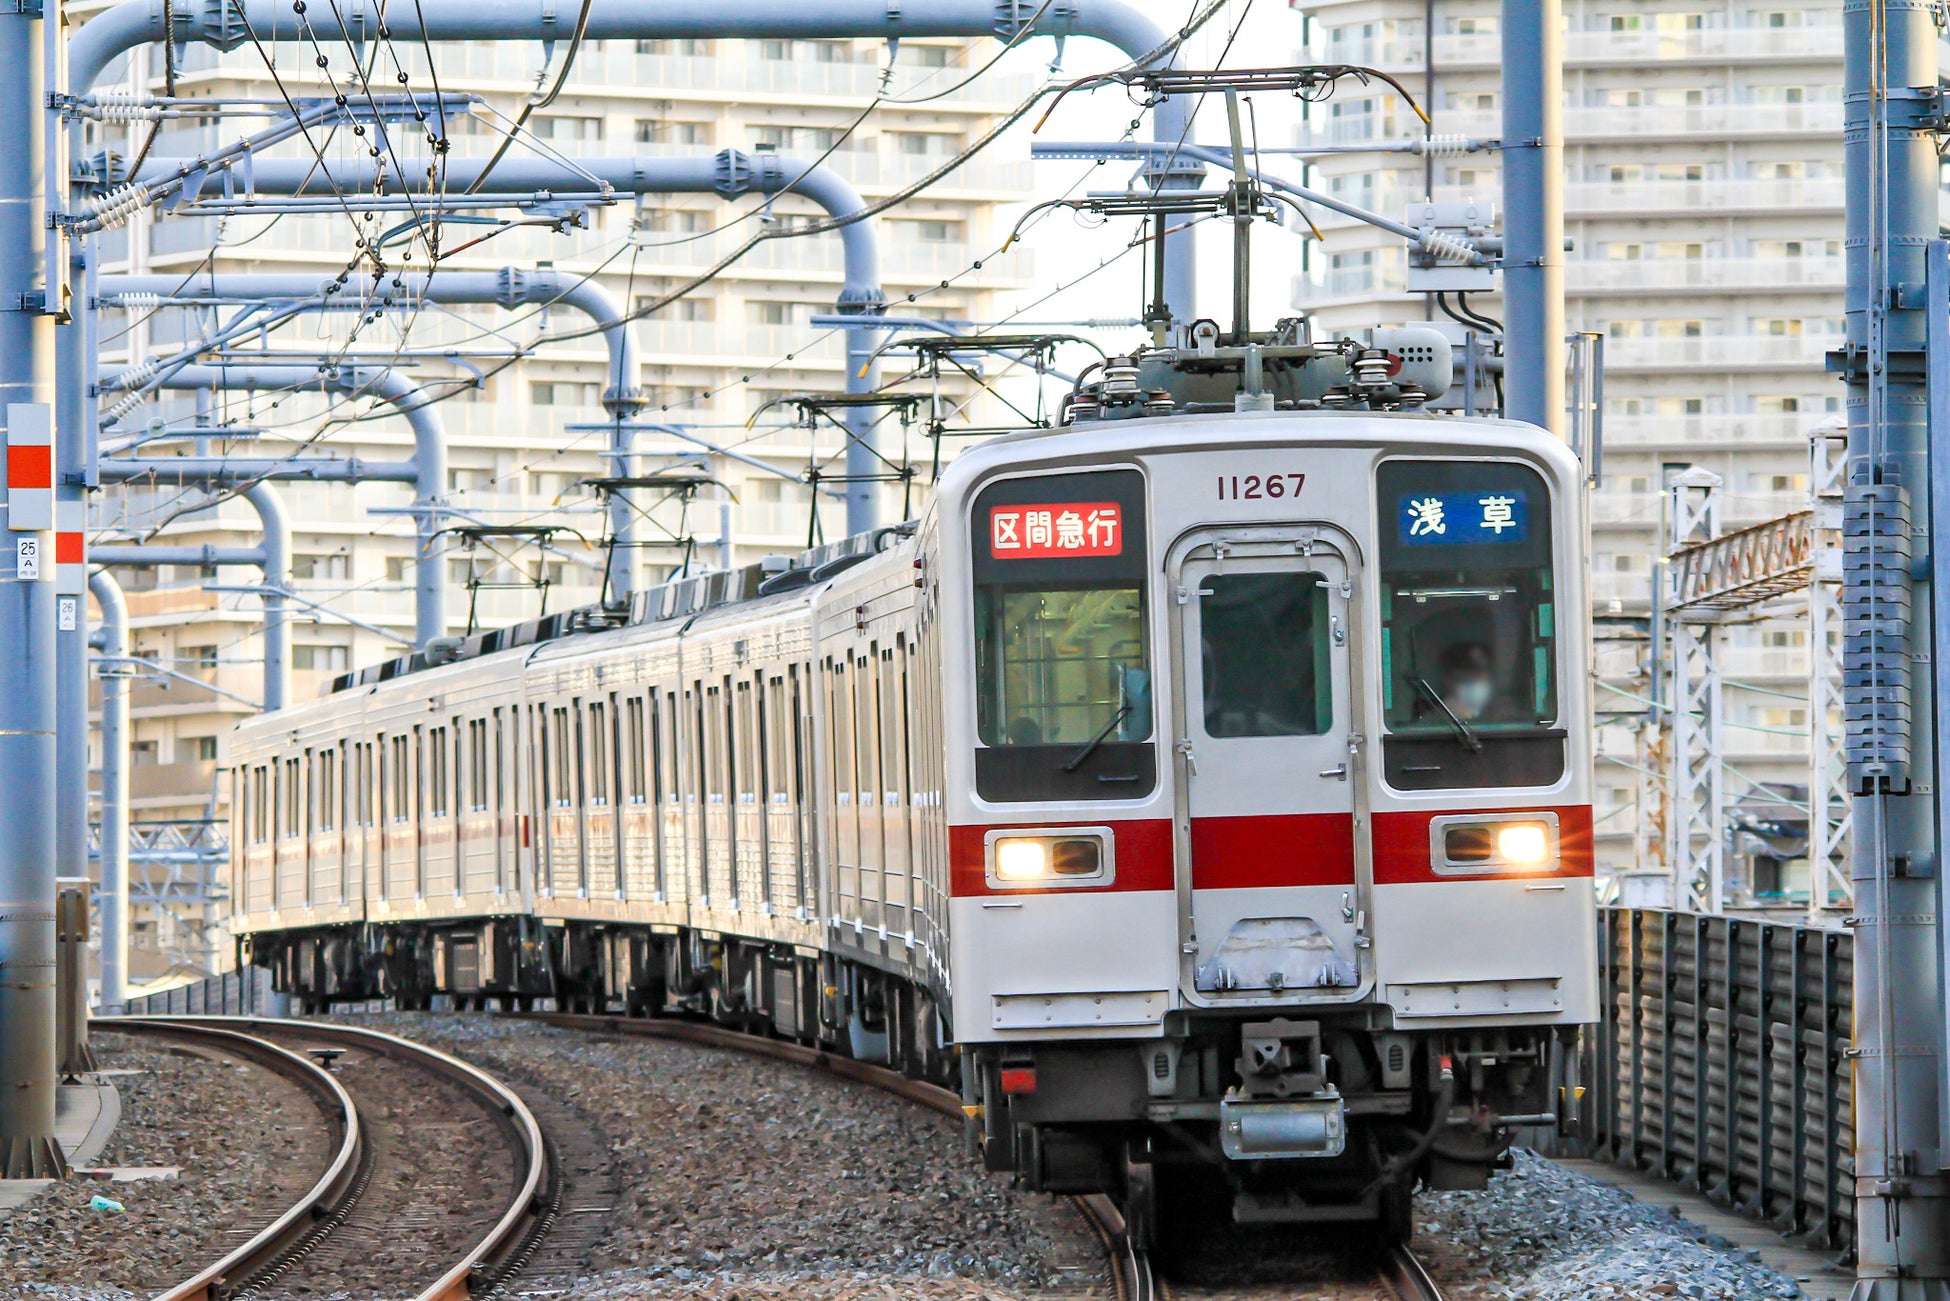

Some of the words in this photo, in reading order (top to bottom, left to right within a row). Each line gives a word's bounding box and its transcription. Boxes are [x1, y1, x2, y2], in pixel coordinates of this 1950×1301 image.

[1218, 473, 1305, 500] 11267
[1407, 495, 1517, 535] 浅草
[993, 509, 1118, 549] 区間急行
[21, 542, 36, 556] 25
[24, 559, 33, 567] A
[62, 602, 74, 614] 26
